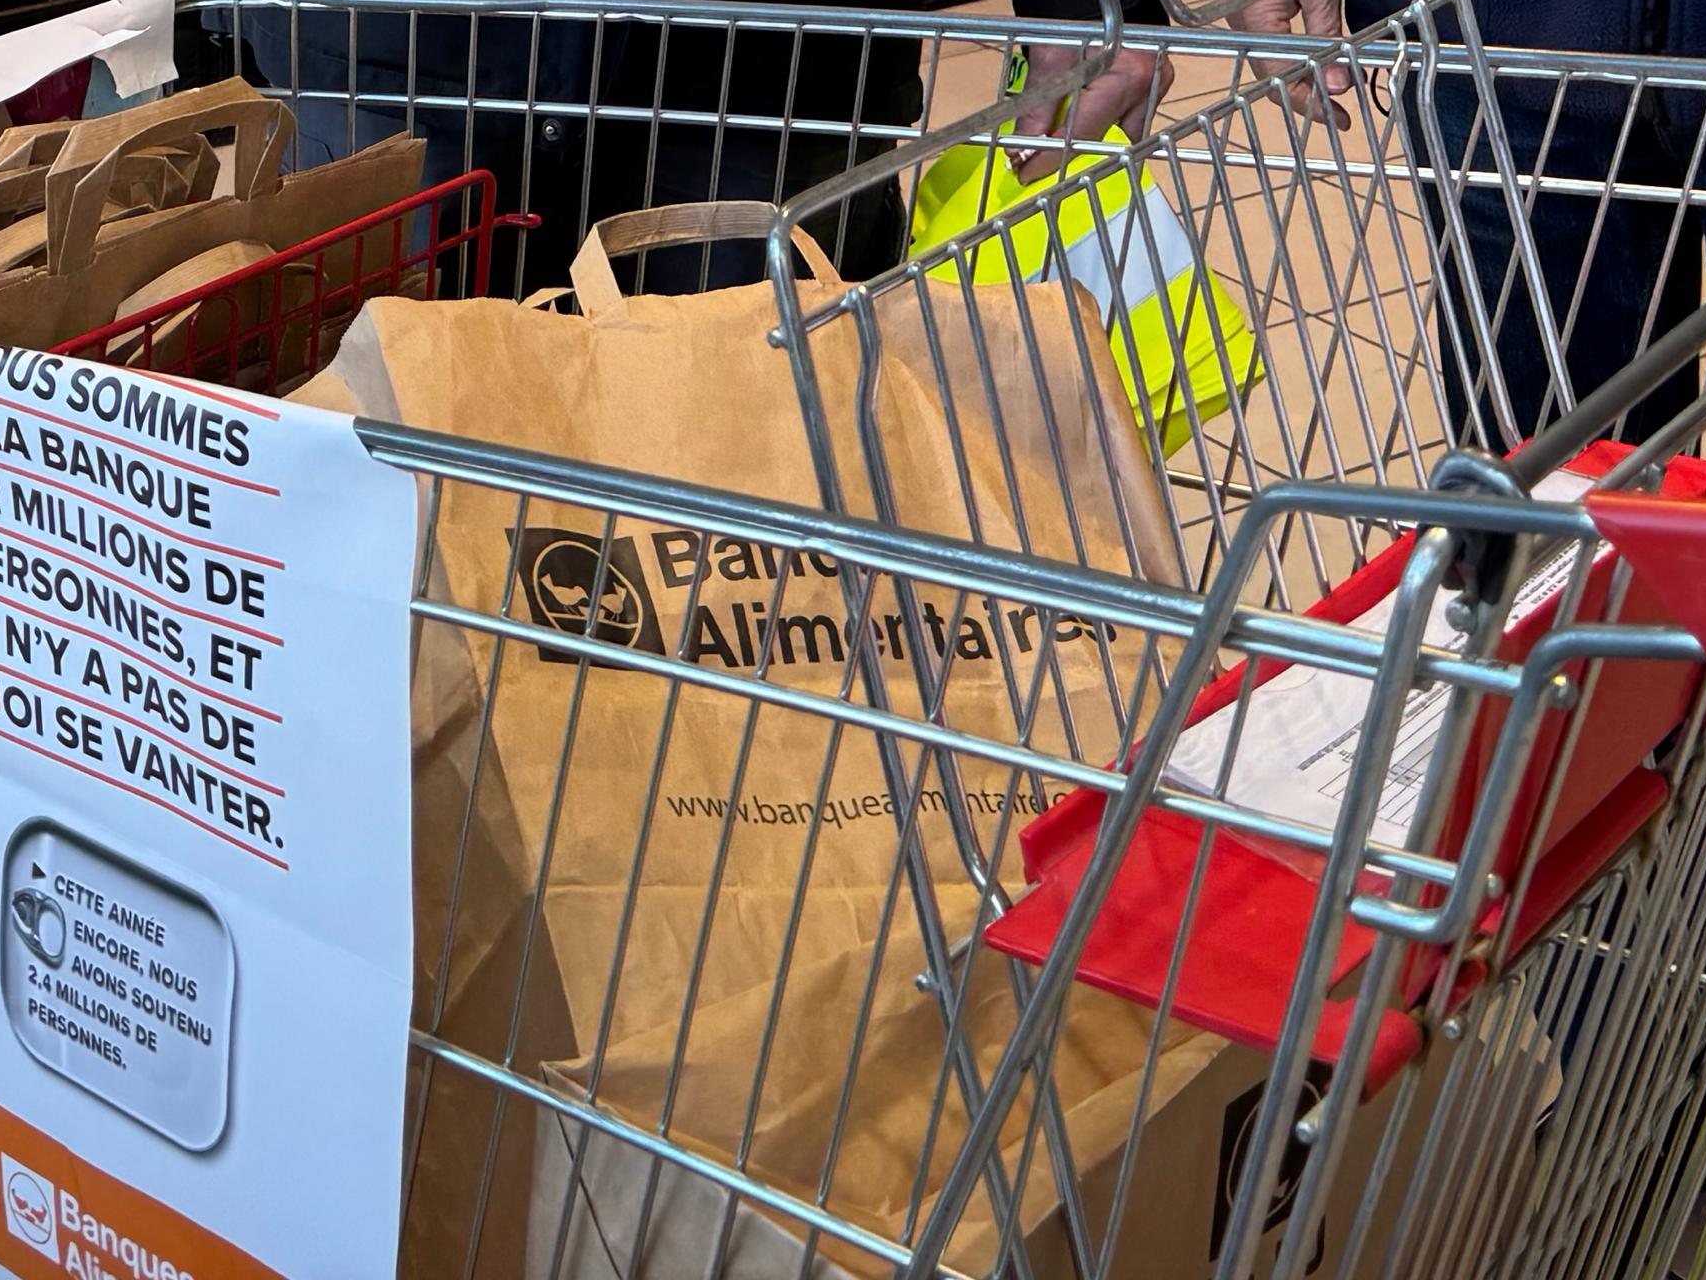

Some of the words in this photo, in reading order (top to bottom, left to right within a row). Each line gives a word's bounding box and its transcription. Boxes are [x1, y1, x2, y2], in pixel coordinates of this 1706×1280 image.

[67, 368, 252, 468] SOMMES
[43, 429, 213, 531] BANQUE
[12, 483, 191, 596] MILLIONS
[204, 560, 267, 619] DE
[4, 615, 71, 677] N'Y
[81, 648, 111, 696] A
[120, 661, 191, 735] PAS
[201, 705, 257, 767] DE
[209, 633, 262, 692] ET
[55, 708, 104, 762] SE
[113, 726, 286, 851] VANTER.
[53, 874, 105, 917] CETTE
[107, 901, 166, 948] ANNÉE
[71, 955, 128, 1001] AVONS
[130, 987, 213, 1047] SOUTENU
[73, 919, 145, 976] ENCORE,
[148, 958, 198, 1003] NOUS
[28, 997, 128, 1071] PERSONNES.
[55, 979, 131, 1038] MILLIONS
[134, 1023, 158, 1053] DE
[59, 1188, 196, 1280] Banques
